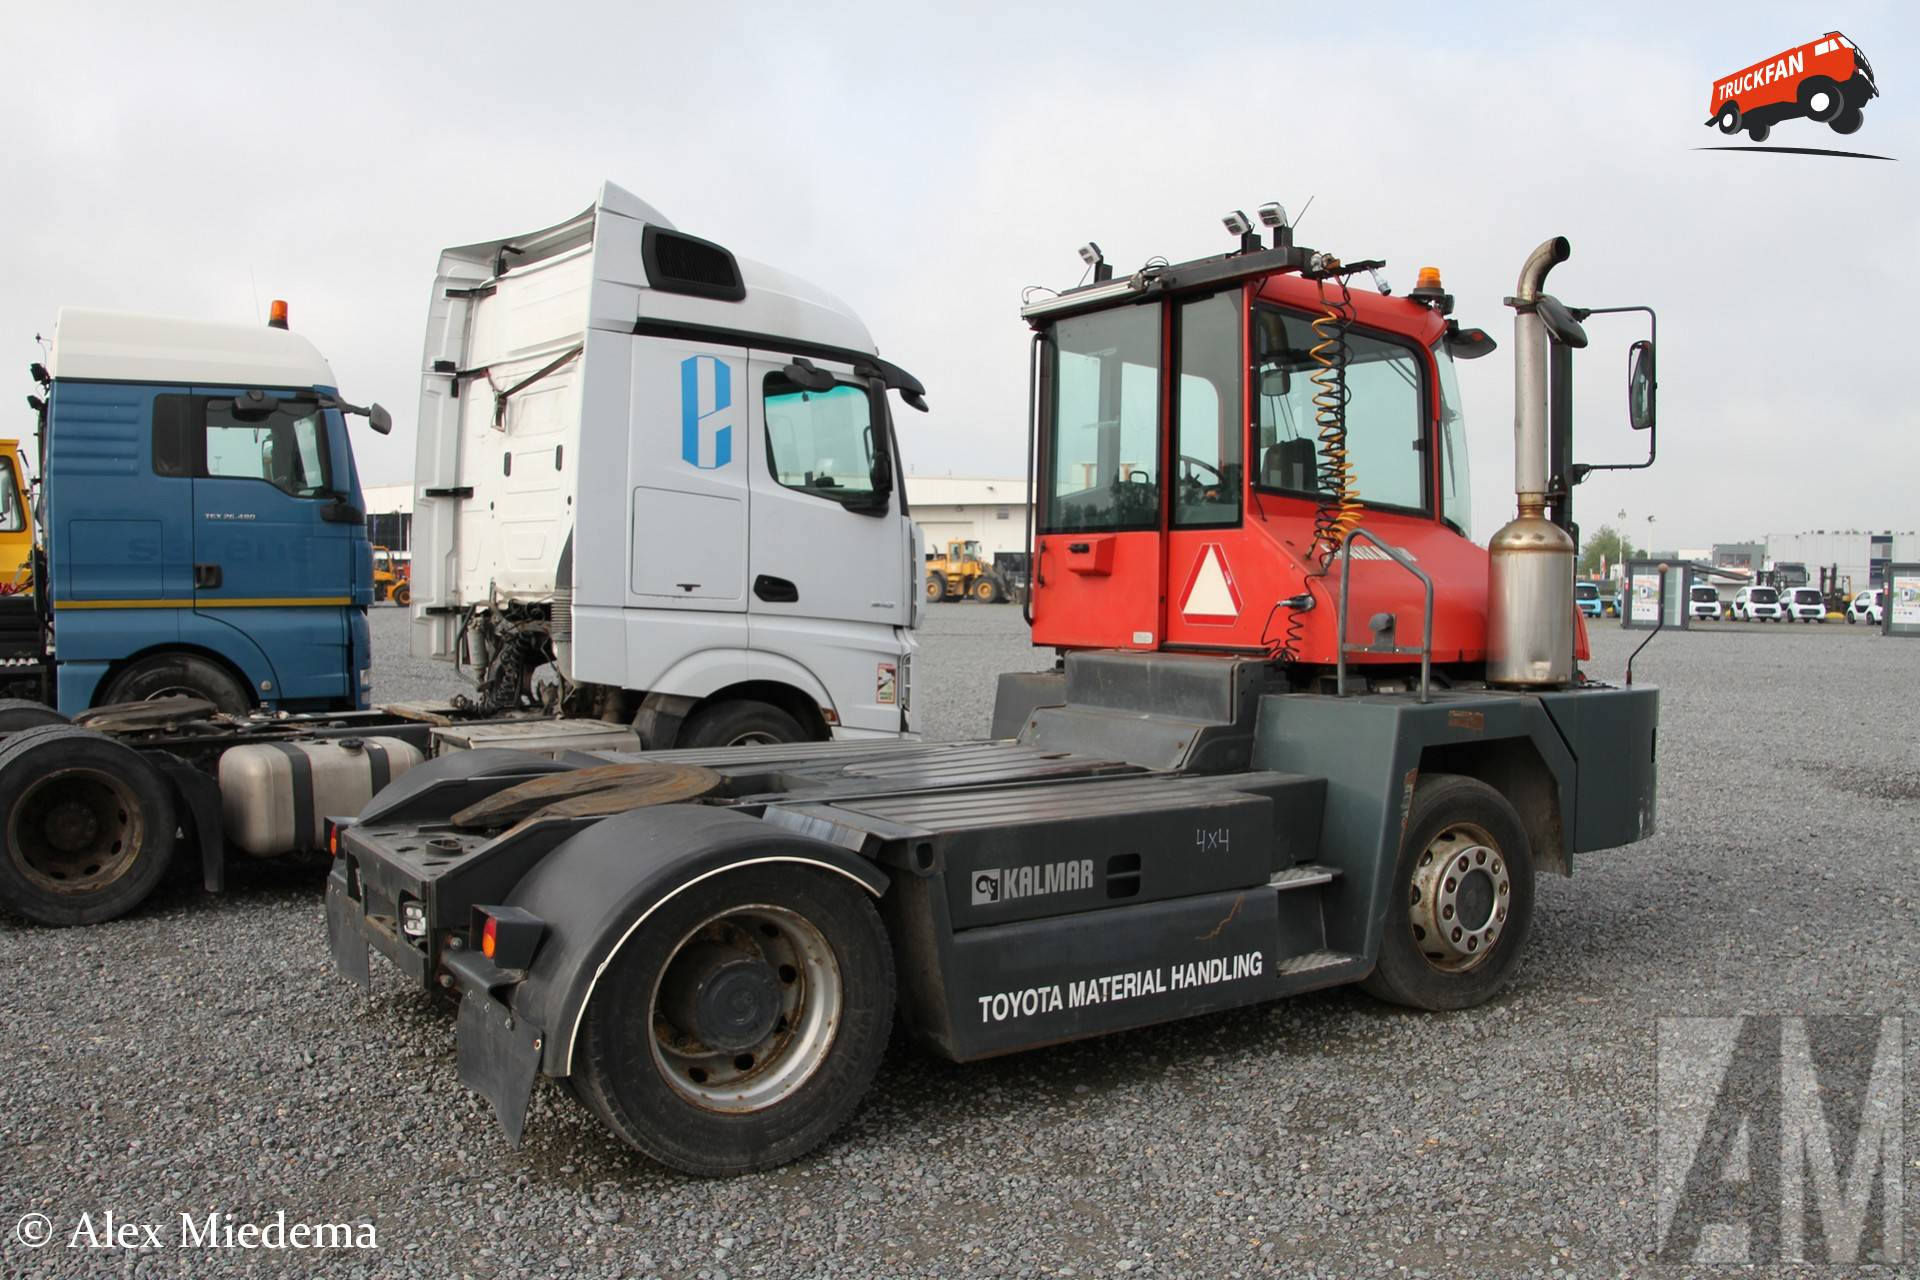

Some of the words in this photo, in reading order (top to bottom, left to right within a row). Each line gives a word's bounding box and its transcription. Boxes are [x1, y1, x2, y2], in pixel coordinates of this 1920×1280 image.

[1196, 828, 1230, 852] 4x4
[1004, 859, 1094, 899] KALMAR
[979, 985, 1063, 1023] TOYOTA
[1068, 969, 1166, 1008] MATERIAL
[1171, 951, 1263, 990] HANDLING
